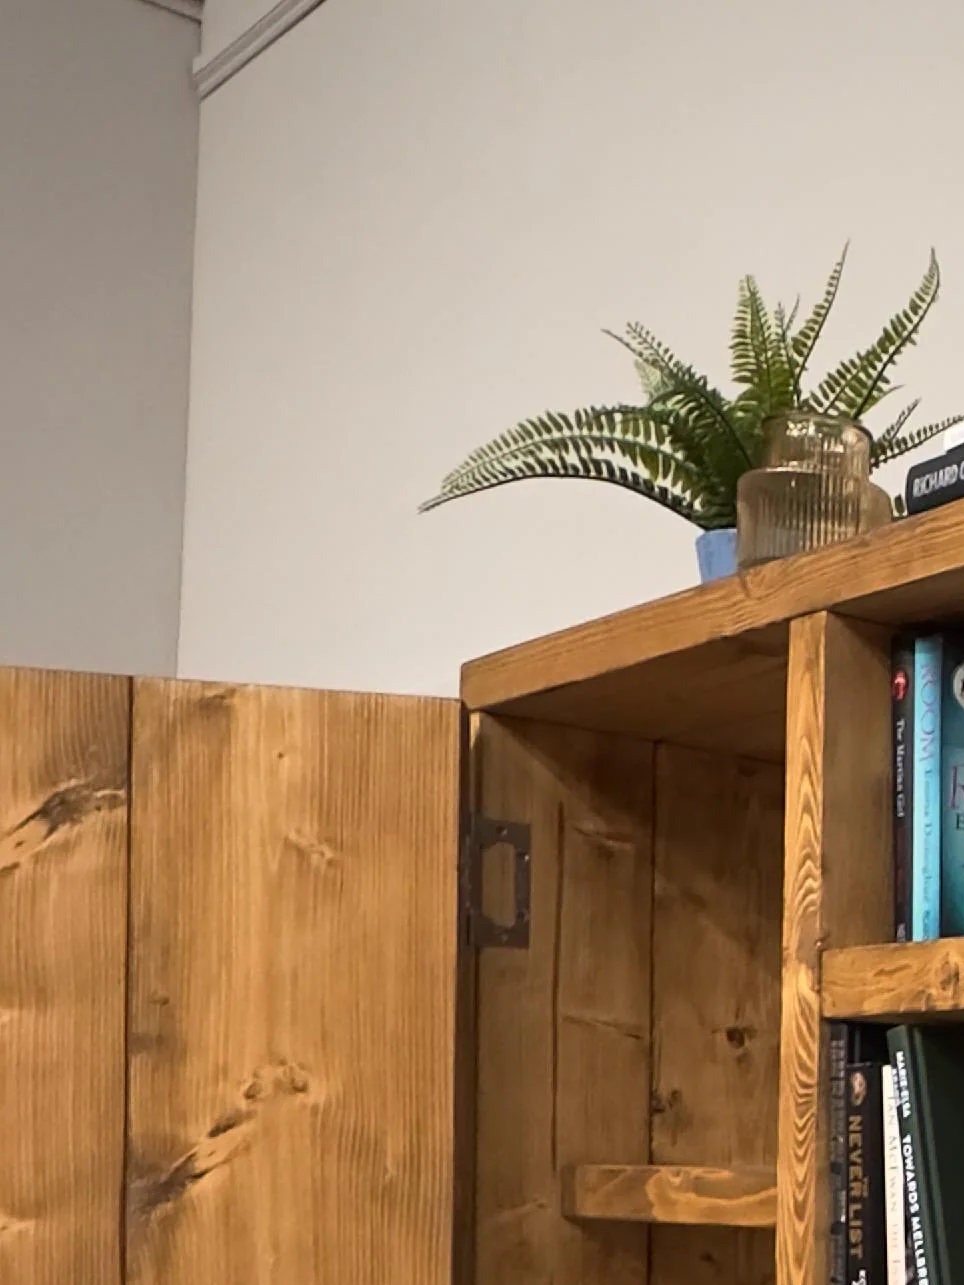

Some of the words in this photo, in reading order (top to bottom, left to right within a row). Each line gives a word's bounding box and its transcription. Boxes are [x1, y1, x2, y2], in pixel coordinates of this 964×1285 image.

[912, 464, 957, 498] RICHARD
[896, 718, 906, 740] The
[919, 664, 938, 762] ROOM
[848, 1115, 863, 1197] NEVER
[902, 1135, 920, 1214] TOWARDS
[848, 1203, 864, 1259] LIST
